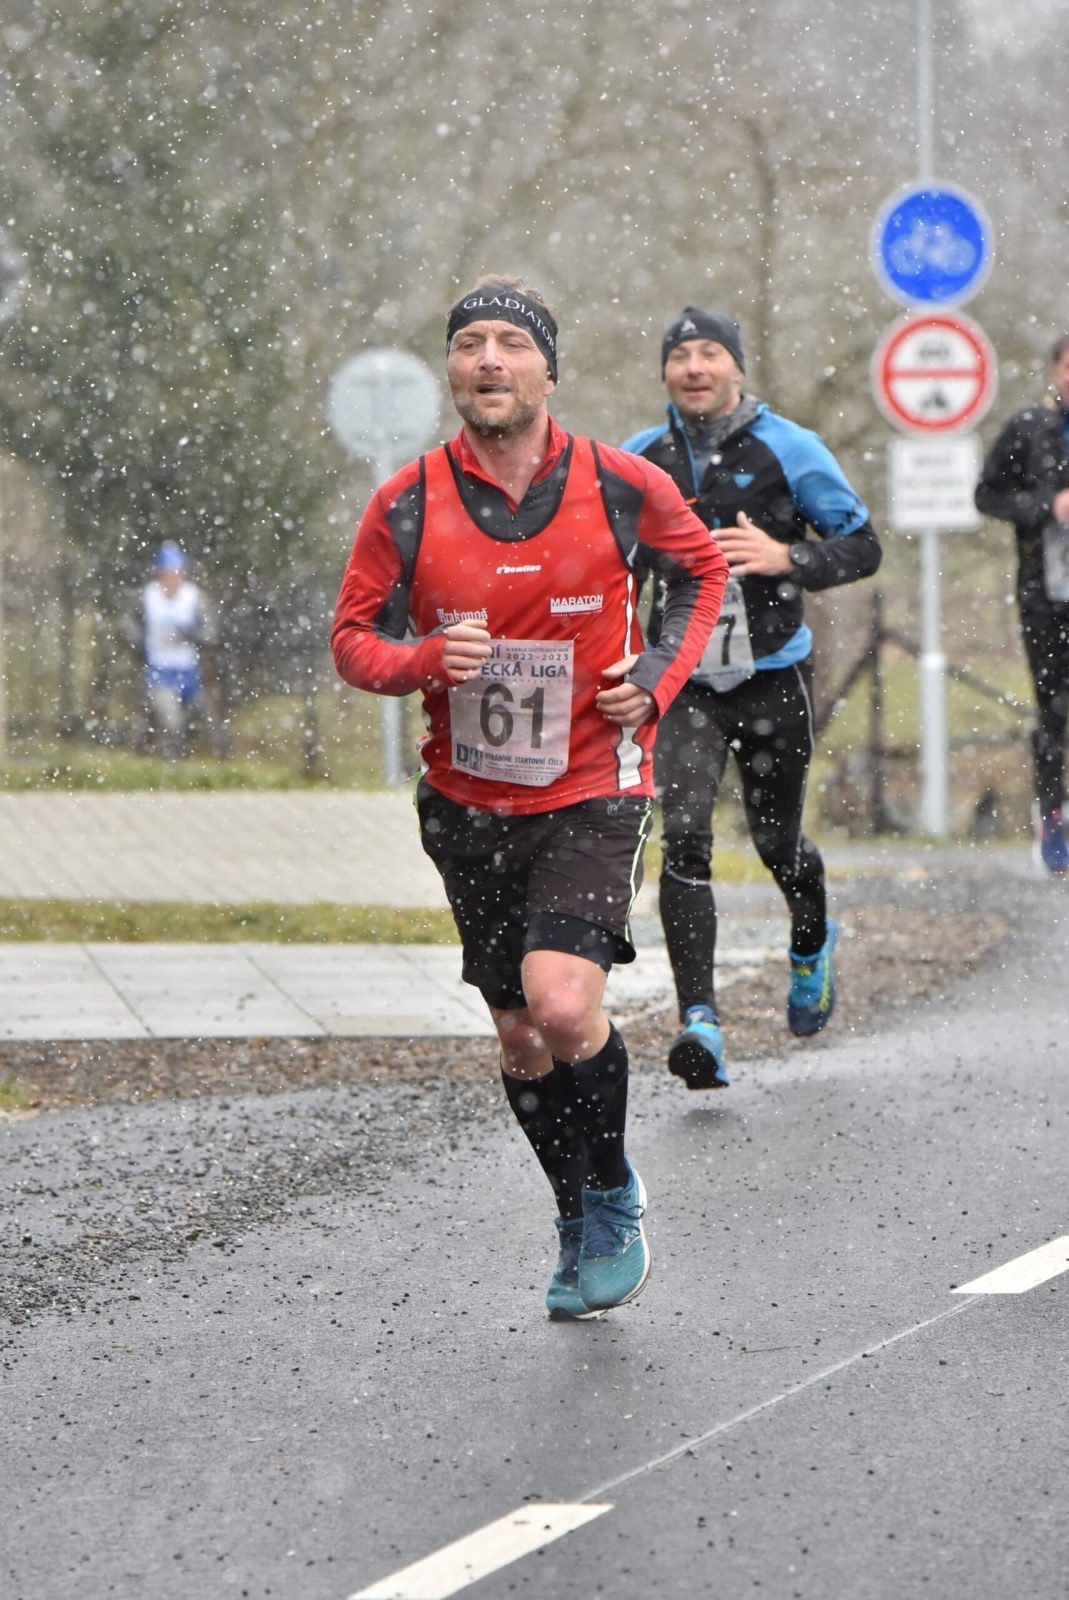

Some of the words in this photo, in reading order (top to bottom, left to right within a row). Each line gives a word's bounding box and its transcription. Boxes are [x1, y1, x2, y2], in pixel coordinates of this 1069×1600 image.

[550, 593, 604, 607] MARATON
[716, 614, 737, 666] 7
[481, 662, 523, 677] ECKÁ
[531, 665, 568, 678] LIGA
[480, 683, 545, 749] 61
[514, 756, 546, 765] STARTOVNÍ
[548, 757, 564, 766] ČÍSLA
